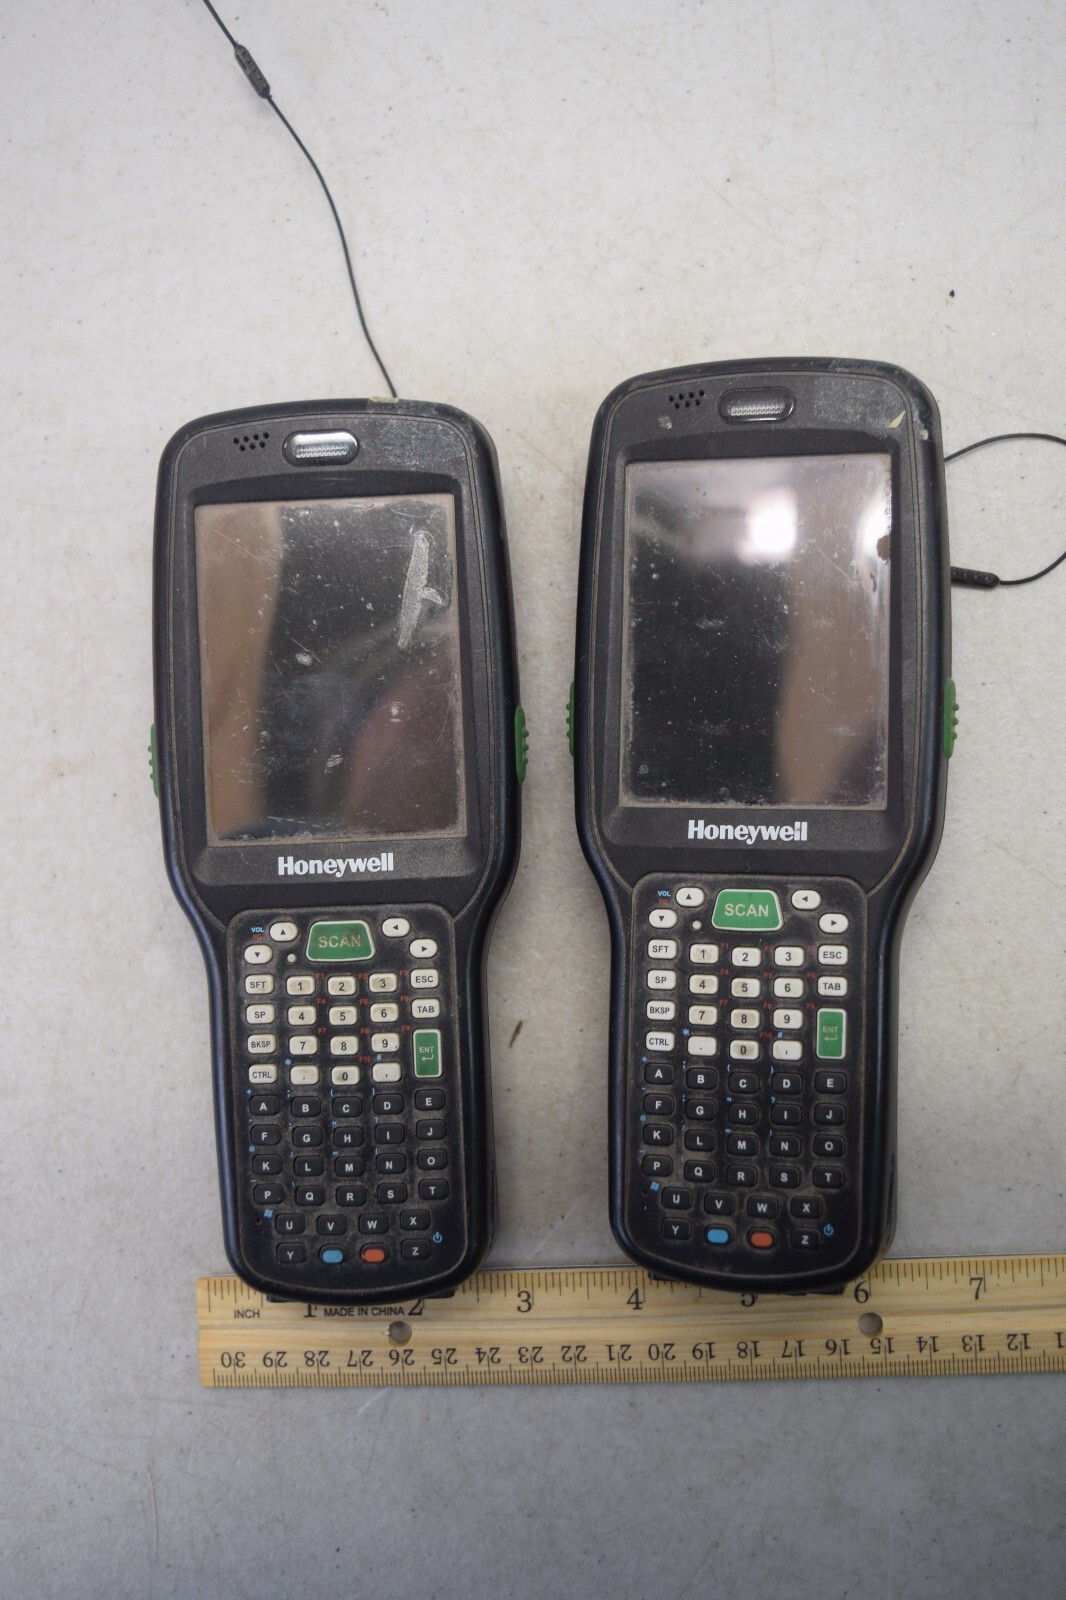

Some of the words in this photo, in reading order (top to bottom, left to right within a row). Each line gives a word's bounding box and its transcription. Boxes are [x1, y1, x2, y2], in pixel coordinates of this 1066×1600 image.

[688, 820, 808, 844] Honeywell
[278, 853, 394, 877] Honeywell
[725, 904, 769, 917] SCAN
[318, 935, 361, 949] SCAN
[700, 949, 705, 958] 1
[742, 953, 748, 962] 2
[785, 952, 792, 961] 3
[823, 951, 842, 959] ESC
[298, 982, 302, 991] 1
[339, 982, 344, 991] 2
[380, 979, 386, 988] 3
[699, 980, 705, 989] 4
[742, 983, 748, 992] 5
[784, 983, 791, 992] 6
[298, 1012, 304, 1021] 4
[340, 1012, 346, 1021] 5
[381, 1009, 387, 1018] 6
[699, 1011, 705, 1020] 7
[741, 1015, 747, 1024] 8
[784, 1015, 790, 1024] 9
[300, 1042, 306, 1050] 7
[341, 1042, 347, 1051] 8
[382, 1039, 388, 1048] 9
[649, 1038, 669, 1046] CTRL
[740, 1046, 746, 1055] 0
[342, 1072, 348, 1081] 0
[655, 1070, 663, 1078] A
[698, 1075, 705, 1083] B
[739, 1079, 747, 1088] C
[827, 1079, 833, 1087] E
[783, 1080, 791, 1088] D
[384, 1102, 391, 1110] D
[426, 1098, 432, 1106] E
[656, 1101, 661, 1109] F
[259, 1103, 267, 1111] A
[302, 1104, 309, 1112] B
[342, 1104, 350, 1112] C
[696, 1106, 704, 1115] G
[739, 1110, 746, 1118] H
[784, 1111, 787, 1119] I
[826, 1111, 832, 1119] J
[262, 1132, 267, 1140] F
[387, 1131, 390, 1139] I
[427, 1128, 433, 1136] J
[653, 1131, 660, 1139] K
[303, 1134, 311, 1142] G
[697, 1137, 703, 1145] L
[738, 1141, 746, 1149] M
[781, 1142, 788, 1150] N
[825, 1142, 833, 1150] O
[386, 1161, 392, 1169] N
[427, 1157, 435, 1165] O
[654, 1162, 660, 1170] P
[694, 1168, 702, 1176] Q
[738, 1172, 745, 1181] R
[781, 1173, 788, 1181] S
[825, 1173, 832, 1181] T
[387, 1190, 394, 1198] S
[429, 1187, 436, 1195] T
[306, 1192, 314, 1201] Q
[347, 1193, 354, 1201] R
[673, 1195, 680, 1203] U
[715, 1201, 722, 1209] V
[757, 1203, 767, 1212] W
[802, 1204, 810, 1212] X
[327, 1222, 334, 1230] V
[367, 1221, 377, 1229] W
[672, 1226, 679, 1234] Y
[802, 1236, 808, 1244] Z
[287, 1251, 294, 1259] Y
[854, 1281, 869, 1303] 6
[970, 1277, 983, 1300] 7
[517, 1290, 532, 1312] 3
[626, 1287, 643, 1310] 4
[234, 1309, 260, 1318] INCH
[304, 1304, 316, 1317] 1
[324, 1307, 354, 1317] MADE
[358, 1307, 368, 1316] IN
[371, 1307, 404, 1316] CHINA
[870, 1337, 895, 1354] 15
[916, 1336, 939, 1353] 14
[962, 1334, 986, 1352] 13
[1007, 1333, 1031, 1350] 12
[648, 1343, 676, 1360] 20
[692, 1342, 716, 1359] 19
[737, 1341, 760, 1358] 18
[782, 1340, 804, 1358] 17
[825, 1339, 851, 1356] 16
[389, 1349, 415, 1365] 26
[431, 1348, 457, 1365] 25
[475, 1347, 501, 1364] 24
[518, 1346, 544, 1363] 23
[561, 1345, 587, 1362] 22
[605, 1344, 632, 1361] 21
[221, 1351, 245, 1368] 30
[263, 1351, 288, 1367] 29
[304, 1351, 329, 1367] 28
[347, 1350, 373, 1367] 27
